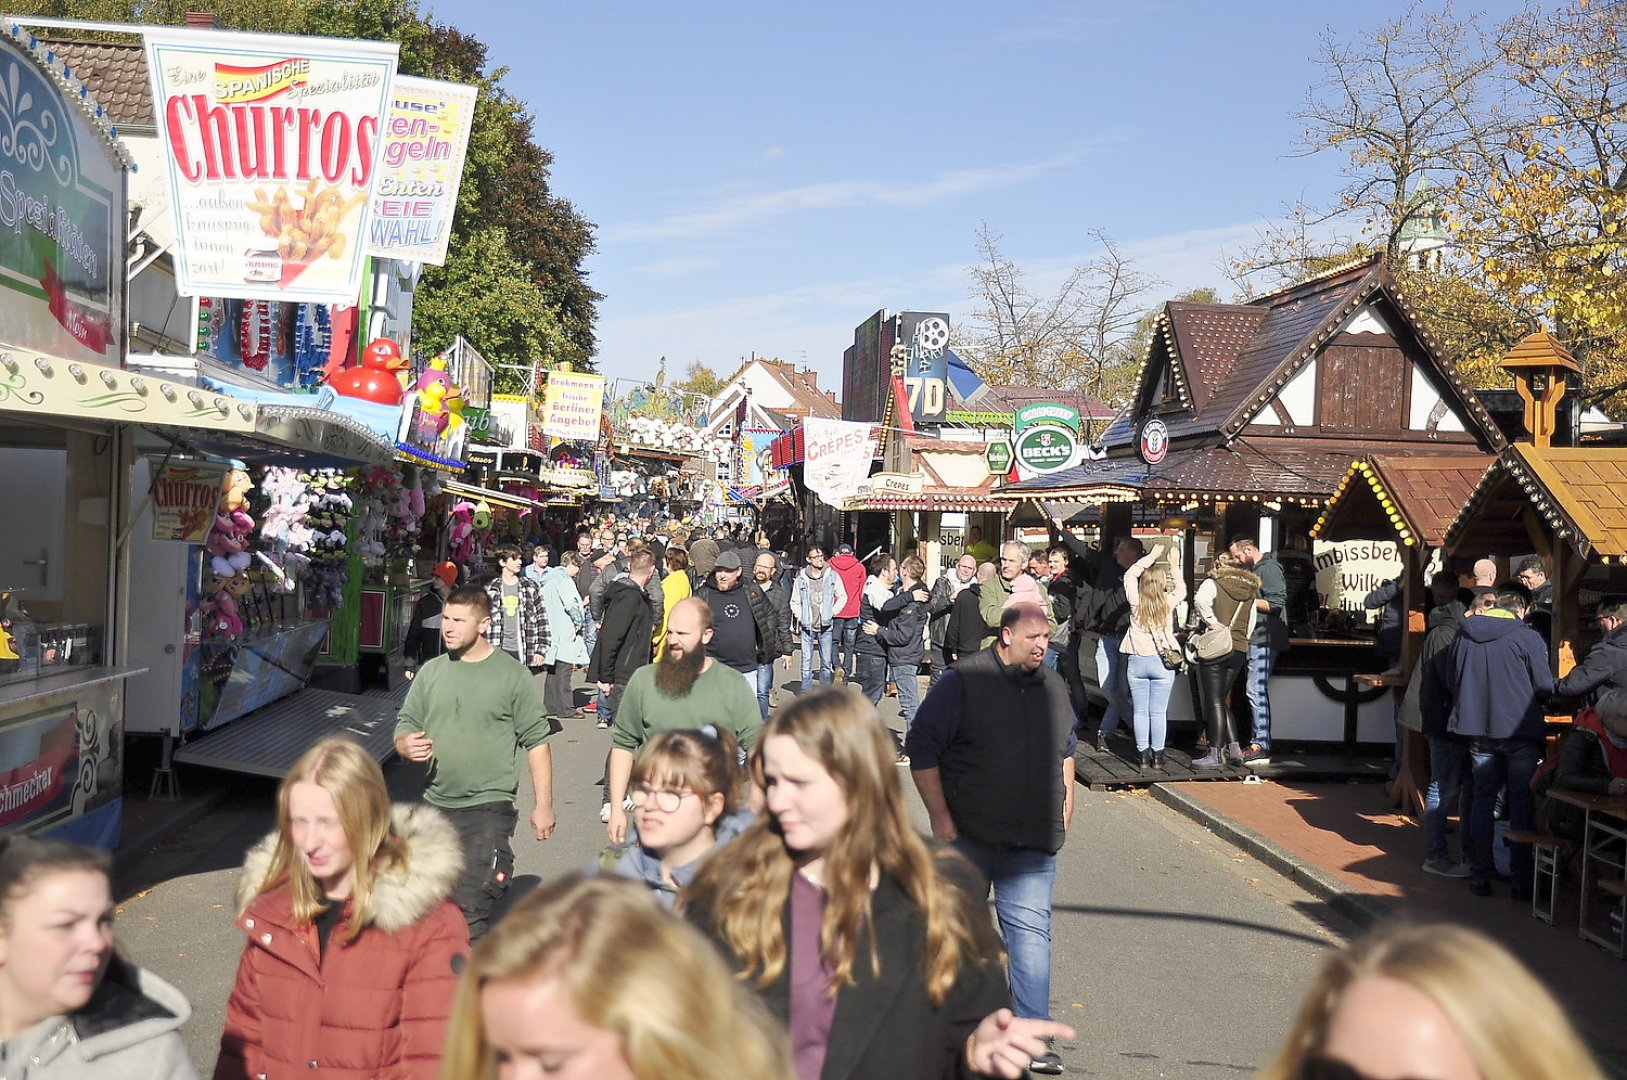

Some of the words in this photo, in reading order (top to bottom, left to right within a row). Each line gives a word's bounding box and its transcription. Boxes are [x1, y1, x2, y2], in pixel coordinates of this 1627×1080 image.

[167, 66, 207, 87] Eine
[211, 58, 310, 99] SPANISCHE
[286, 72, 381, 104] Spezialität
[166, 94, 380, 188] Churros
[377, 177, 445, 197] Enten
[0, 170, 98, 279] Spezialitäten
[552, 402, 597, 414] Berliner
[905, 376, 945, 416] 7D
[550, 413, 597, 427] Angebot
[1022, 445, 1071, 458] BECK'S
[153, 478, 219, 509] Churros
